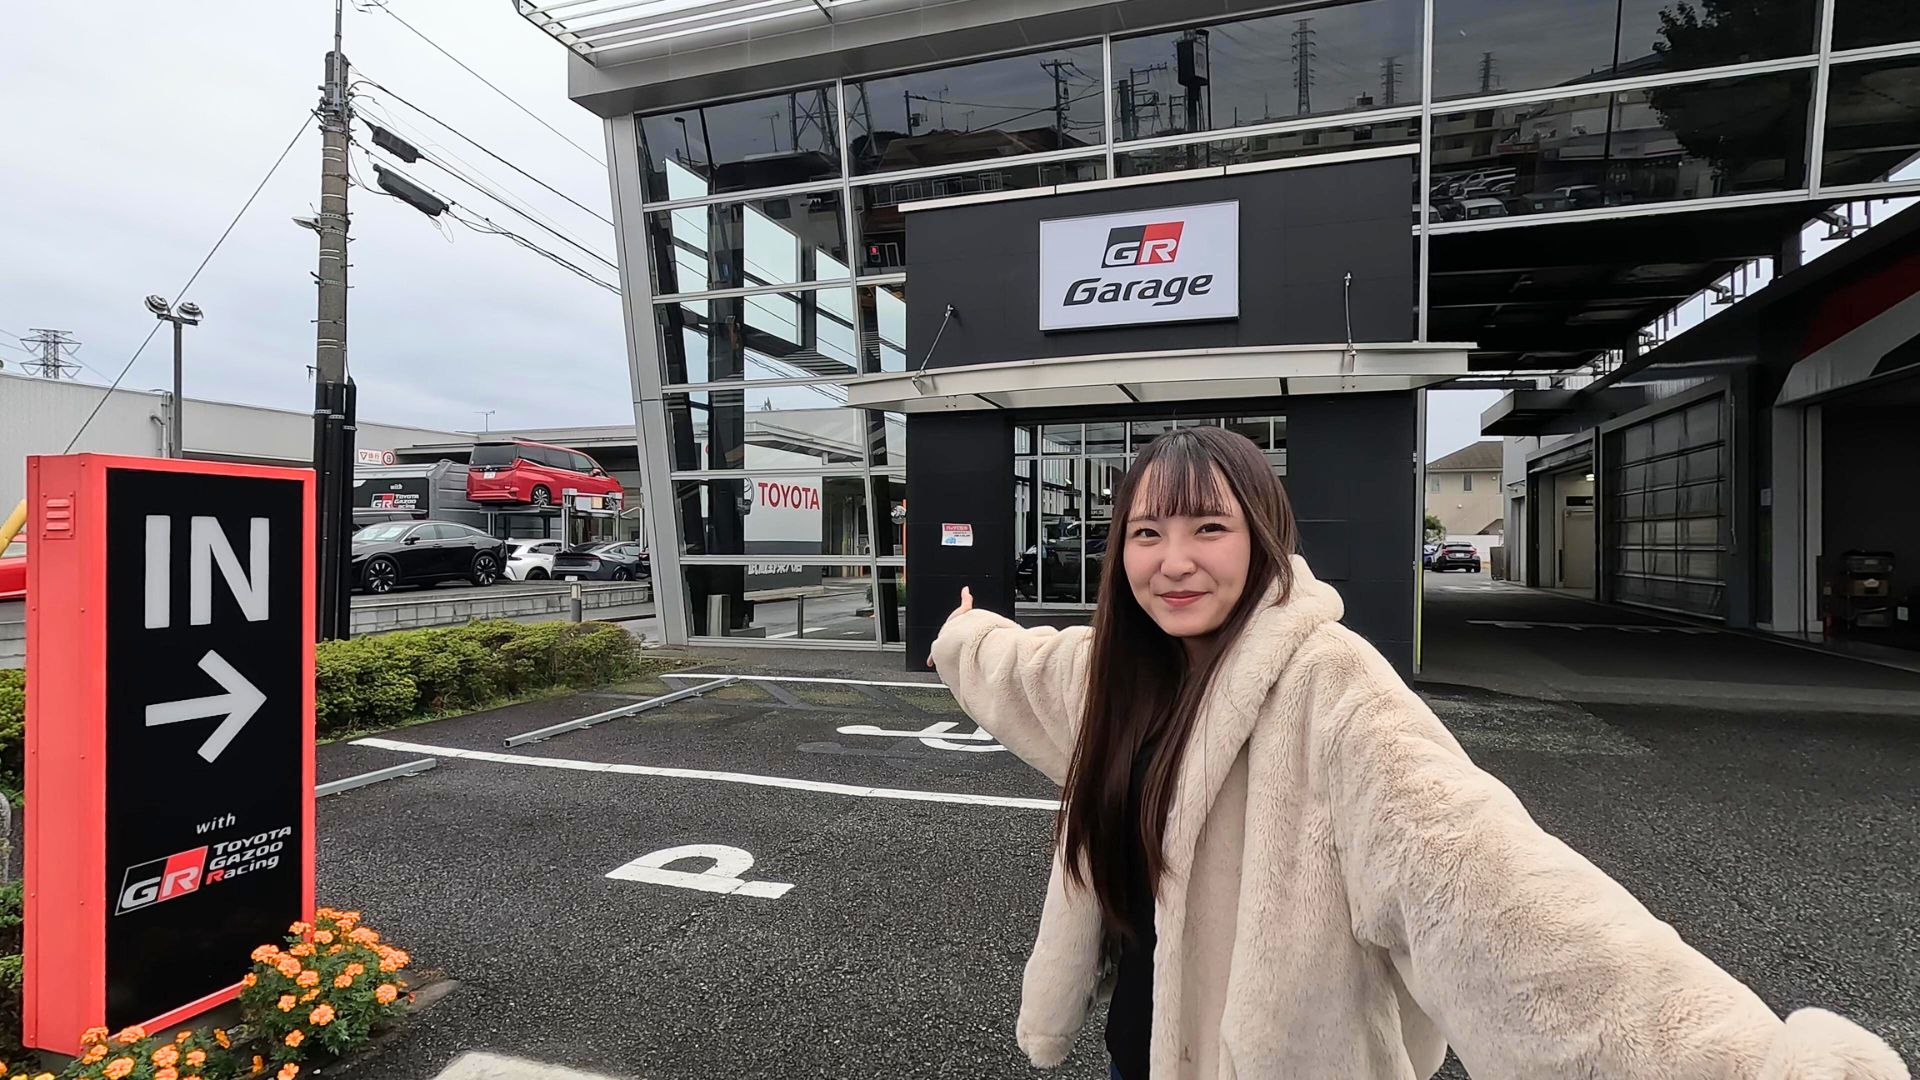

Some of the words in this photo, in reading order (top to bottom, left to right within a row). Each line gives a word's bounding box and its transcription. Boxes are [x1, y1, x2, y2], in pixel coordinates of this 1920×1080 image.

[1104, 238, 1177, 266] GR
[1063, 274, 1213, 306] Garage
[758, 482, 820, 510] TOYOTA
[145, 515, 269, 628] IN
[196, 813, 236, 834] with
[209, 841, 283, 871] GAZOO
[213, 826, 292, 856] TOYOTA
[206, 855, 279, 885] Racing
[605, 844, 794, 899] P
[121, 866, 198, 909] GR
